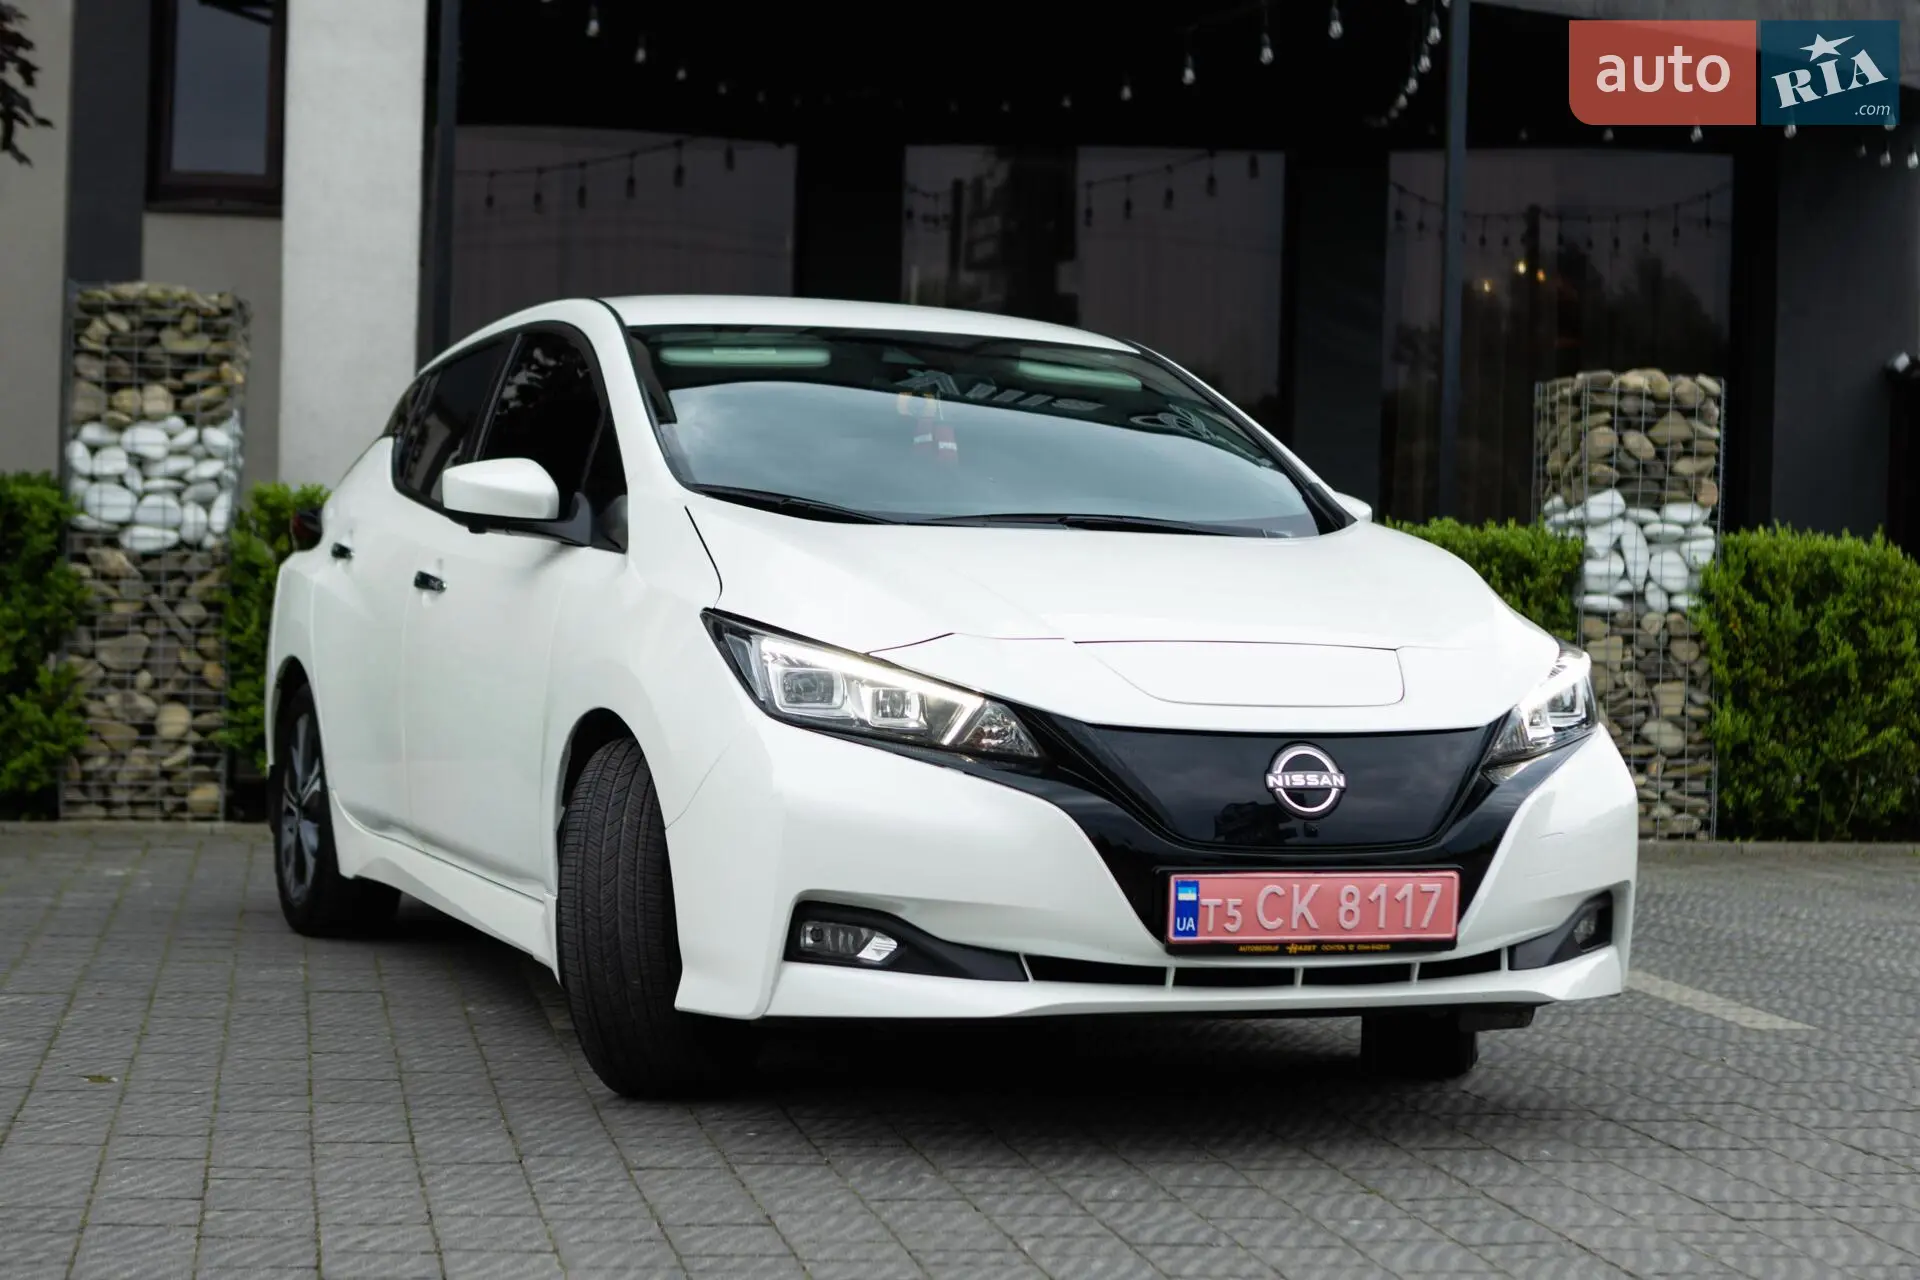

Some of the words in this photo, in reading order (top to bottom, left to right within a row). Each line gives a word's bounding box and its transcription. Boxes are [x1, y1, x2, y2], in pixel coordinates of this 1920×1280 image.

[1268, 774, 1345, 788] NISSAN
[1201, 899, 1242, 932] T5
[1256, 884, 1320, 930] CK
[1338, 883, 1443, 930] 8117
[1176, 917, 1195, 932] UA
